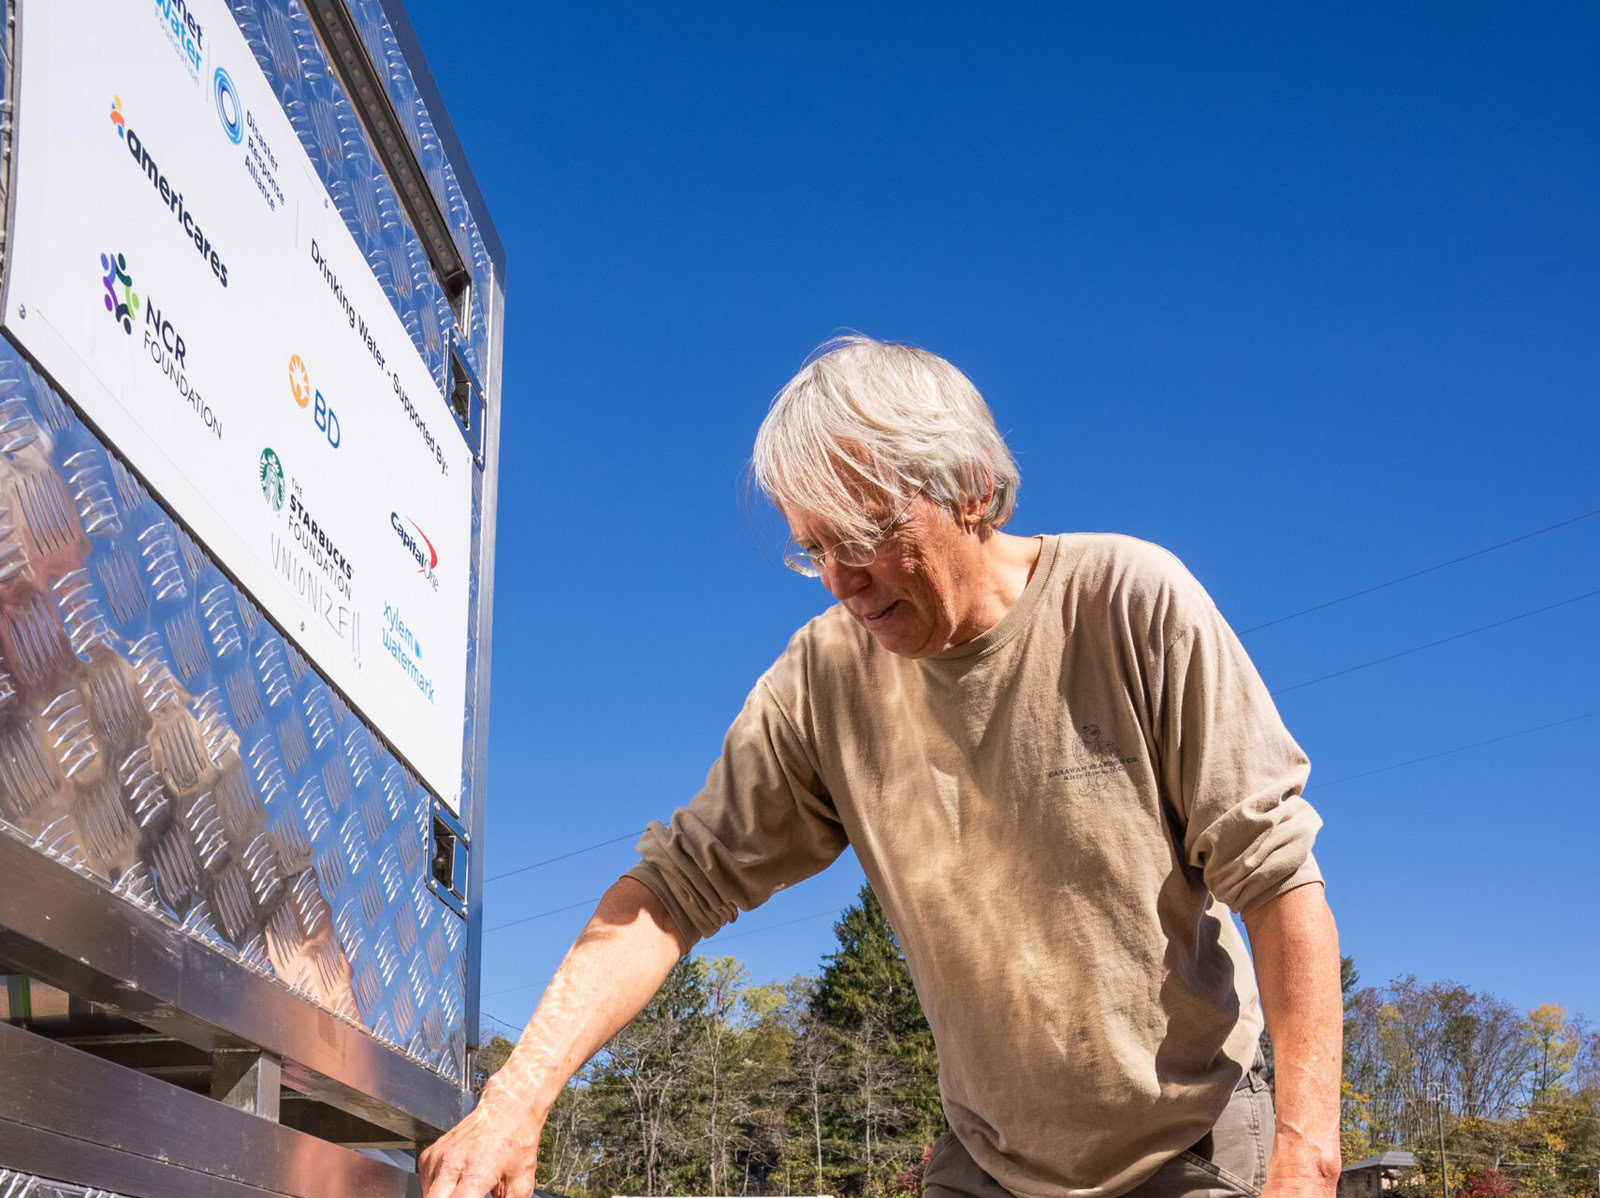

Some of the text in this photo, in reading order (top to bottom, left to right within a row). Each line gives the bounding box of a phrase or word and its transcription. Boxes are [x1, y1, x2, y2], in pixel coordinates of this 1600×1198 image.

[171, 0, 203, 51] net
[246, 110, 279, 173] Disaster
[247, 135, 285, 206] Response
[127, 129, 228, 288] americares
[244, 154, 276, 212] Alliance
[146, 296, 186, 370] NCR
[311, 238, 356, 328] Drinking
[358, 313, 386, 371] Water
[393, 373, 435, 451] Supported
[436, 444, 449, 477] By:
[143, 330, 223, 440] FOUNDATION
[314, 388, 341, 449] BD
[291, 476, 303, 498] THE
[288, 514, 352, 602] FOUNDATION
[290, 494, 352, 580] STARBUCKS
[383, 600, 414, 651] xylem
[382, 627, 435, 705] watermark
